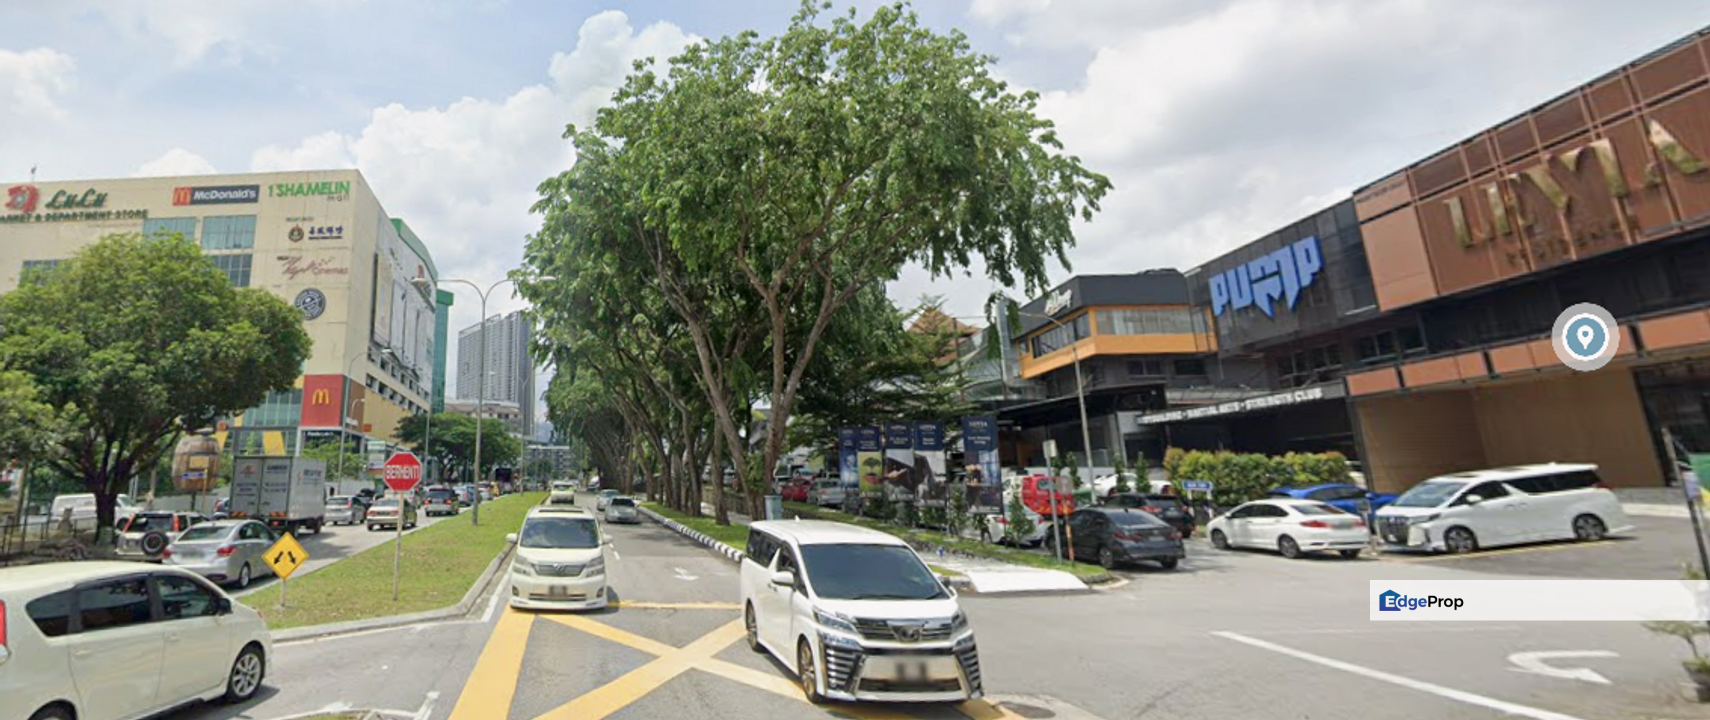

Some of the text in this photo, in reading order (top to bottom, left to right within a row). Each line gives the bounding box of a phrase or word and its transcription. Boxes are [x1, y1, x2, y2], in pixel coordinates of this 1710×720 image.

[193, 189, 257, 201] McDonald's
[276, 181, 351, 198] SHAMELIN
[45, 210, 112, 221] DEPARTMENT
[115, 209, 149, 219] STORE
[1208, 235, 1325, 319] PUMP
[1294, 387, 1323, 401] CLUB
[386, 465, 421, 480] BERHENTI
